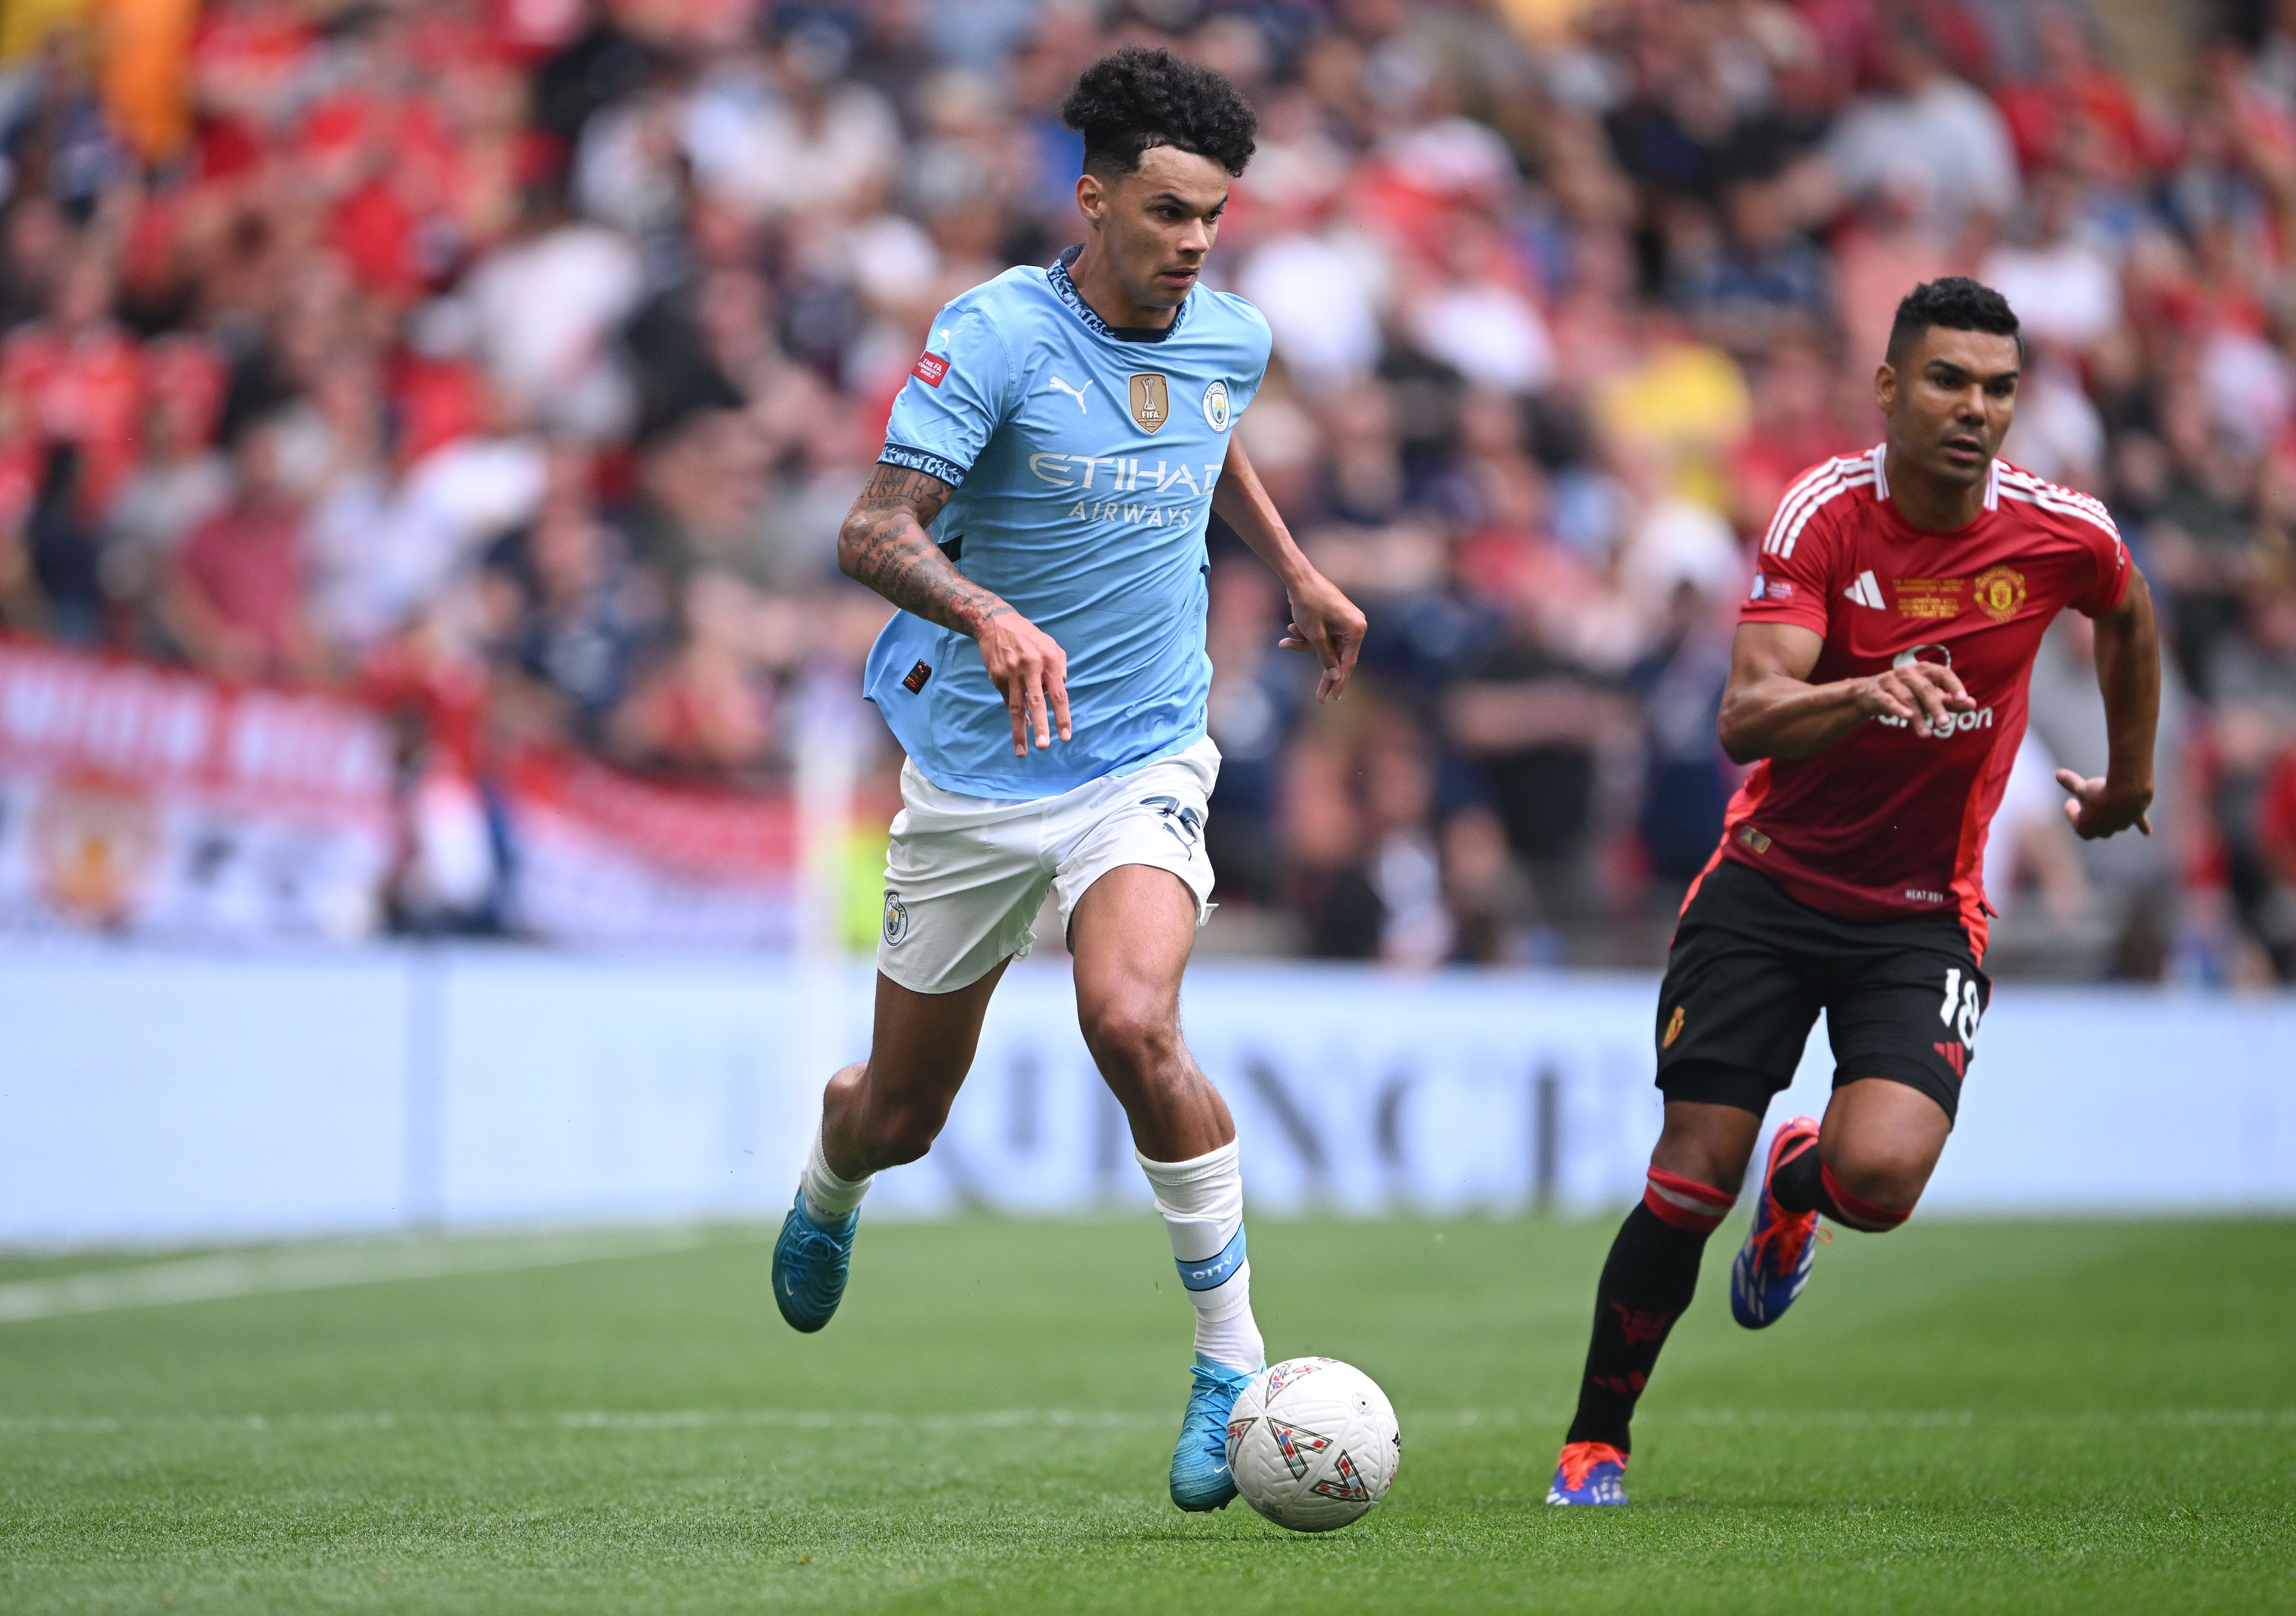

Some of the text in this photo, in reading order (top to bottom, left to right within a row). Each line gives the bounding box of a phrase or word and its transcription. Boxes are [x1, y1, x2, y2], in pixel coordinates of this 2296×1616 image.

[917, 362, 941, 377] COMMUNITY
[920, 368, 935, 379] SHIELD
[923, 358, 942, 372] THE FA
[1206, 383, 1227, 400] MANCHESTER
[1069, 501, 1191, 528] AIRWAYS
[1939, 968, 1980, 1051] 18
[1192, 1253, 1233, 1281] CITY
